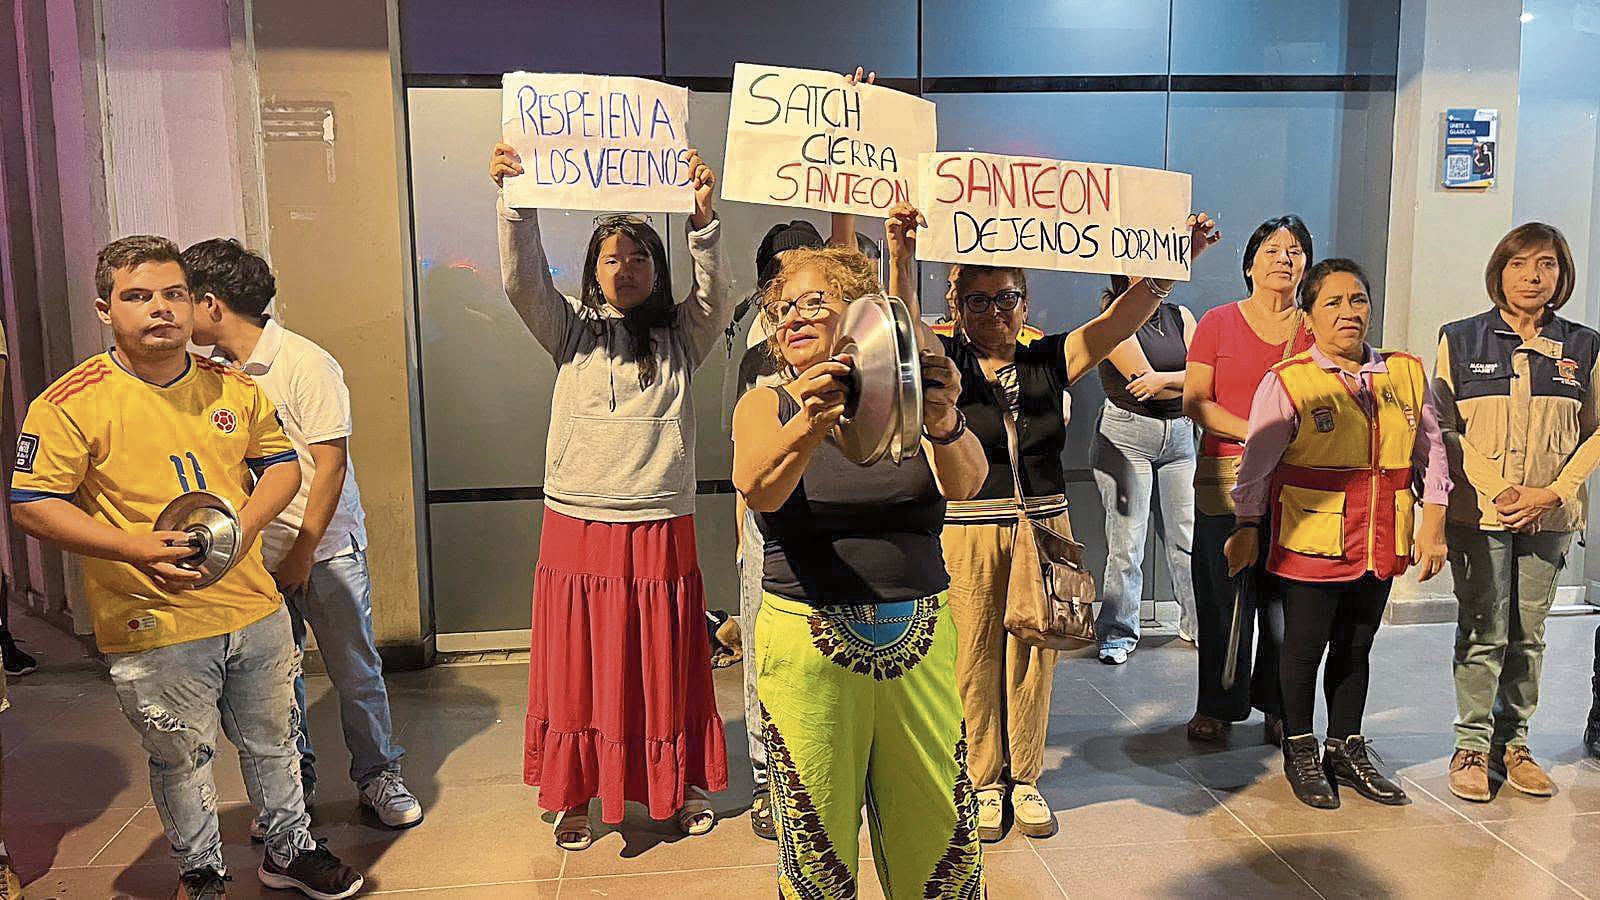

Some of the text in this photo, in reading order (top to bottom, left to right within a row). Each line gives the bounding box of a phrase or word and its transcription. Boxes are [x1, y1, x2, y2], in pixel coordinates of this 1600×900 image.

[650, 98, 675, 139] A
[745, 73, 860, 131] SATCH
[534, 148, 692, 188] LOS VECINOS
[802, 133, 897, 172] CIERRA
[769, 163, 909, 208] SANTEON
[936, 157, 1113, 215] SANTEON
[954, 211, 1100, 258] DEJENOS
[169, 451, 207, 493] 11
